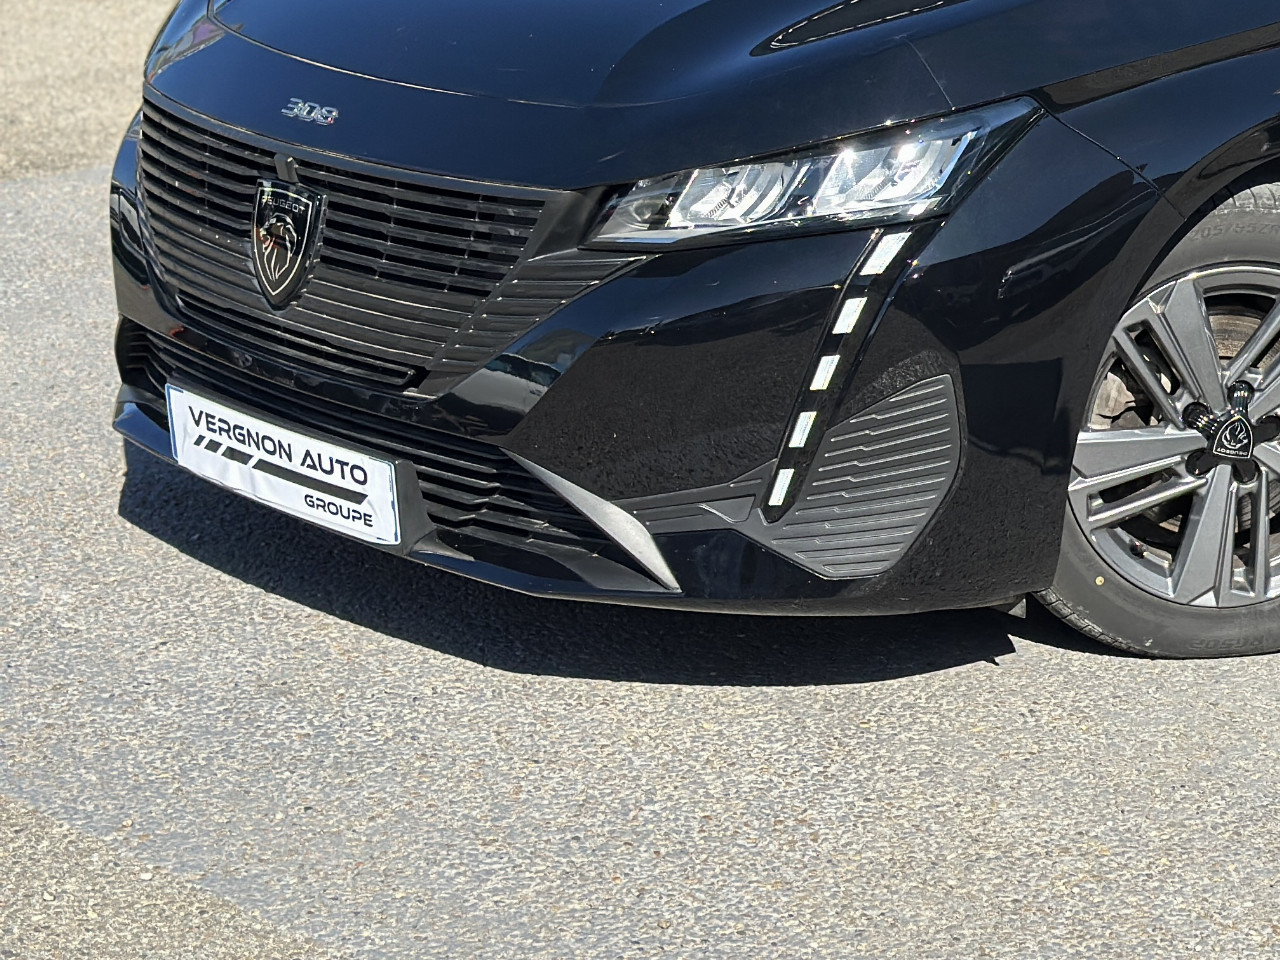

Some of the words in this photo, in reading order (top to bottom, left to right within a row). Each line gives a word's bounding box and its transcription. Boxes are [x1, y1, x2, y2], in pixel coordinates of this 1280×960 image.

[281, 97, 339, 125] 308
[261, 195, 306, 214] PEUGEOT
[188, 405, 293, 463] VERGNON
[300, 449, 368, 486] AUTO
[304, 493, 374, 528] GROUPE
